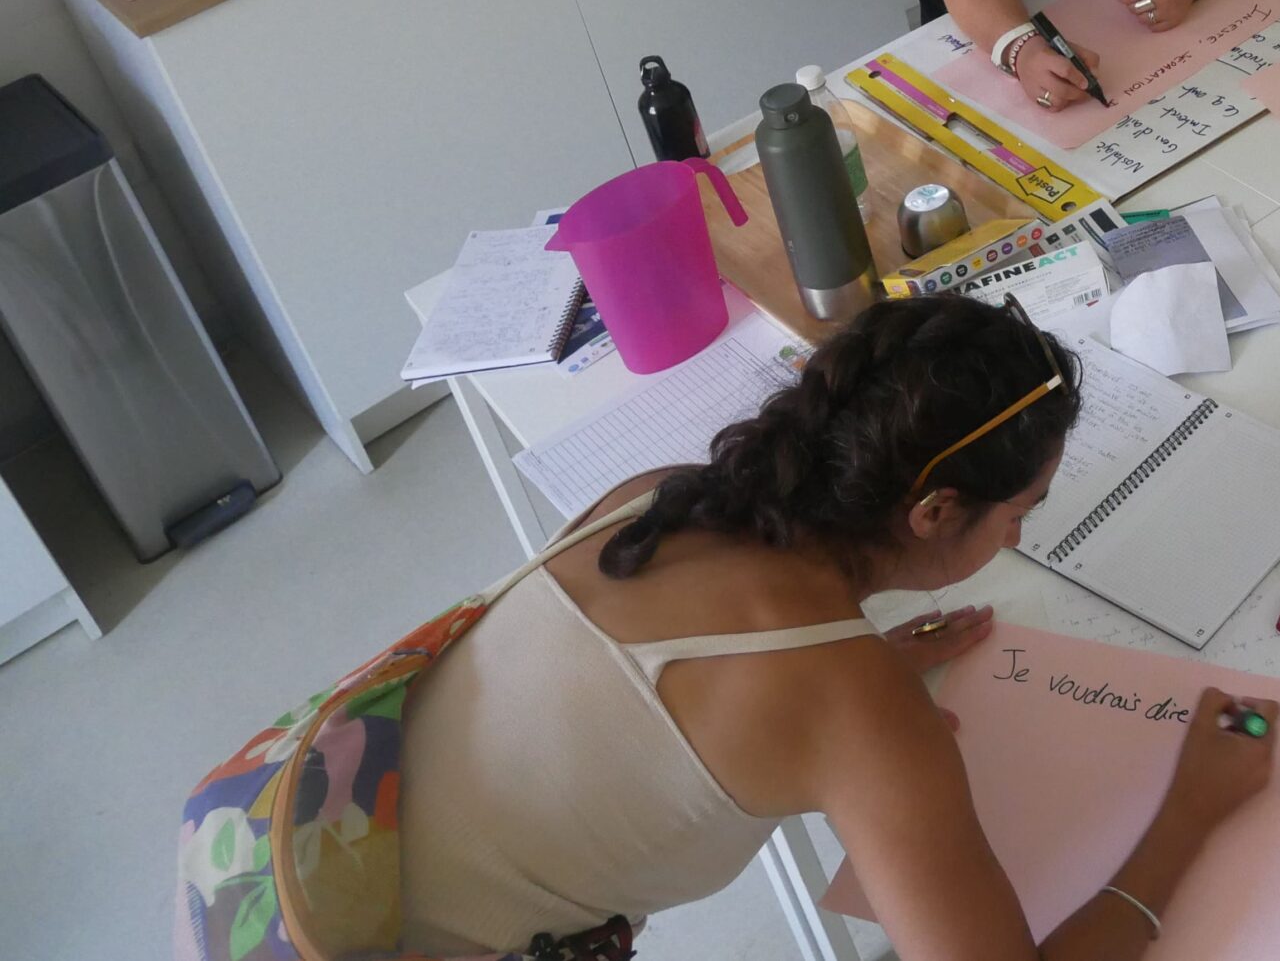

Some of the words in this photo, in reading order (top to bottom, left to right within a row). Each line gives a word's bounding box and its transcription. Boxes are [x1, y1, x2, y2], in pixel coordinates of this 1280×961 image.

[1028, 174, 1060, 197] Post-it
[993, 649, 1029, 682] Je
[1049, 674, 1141, 711] voudrais
[1145, 697, 1190, 723] dire
